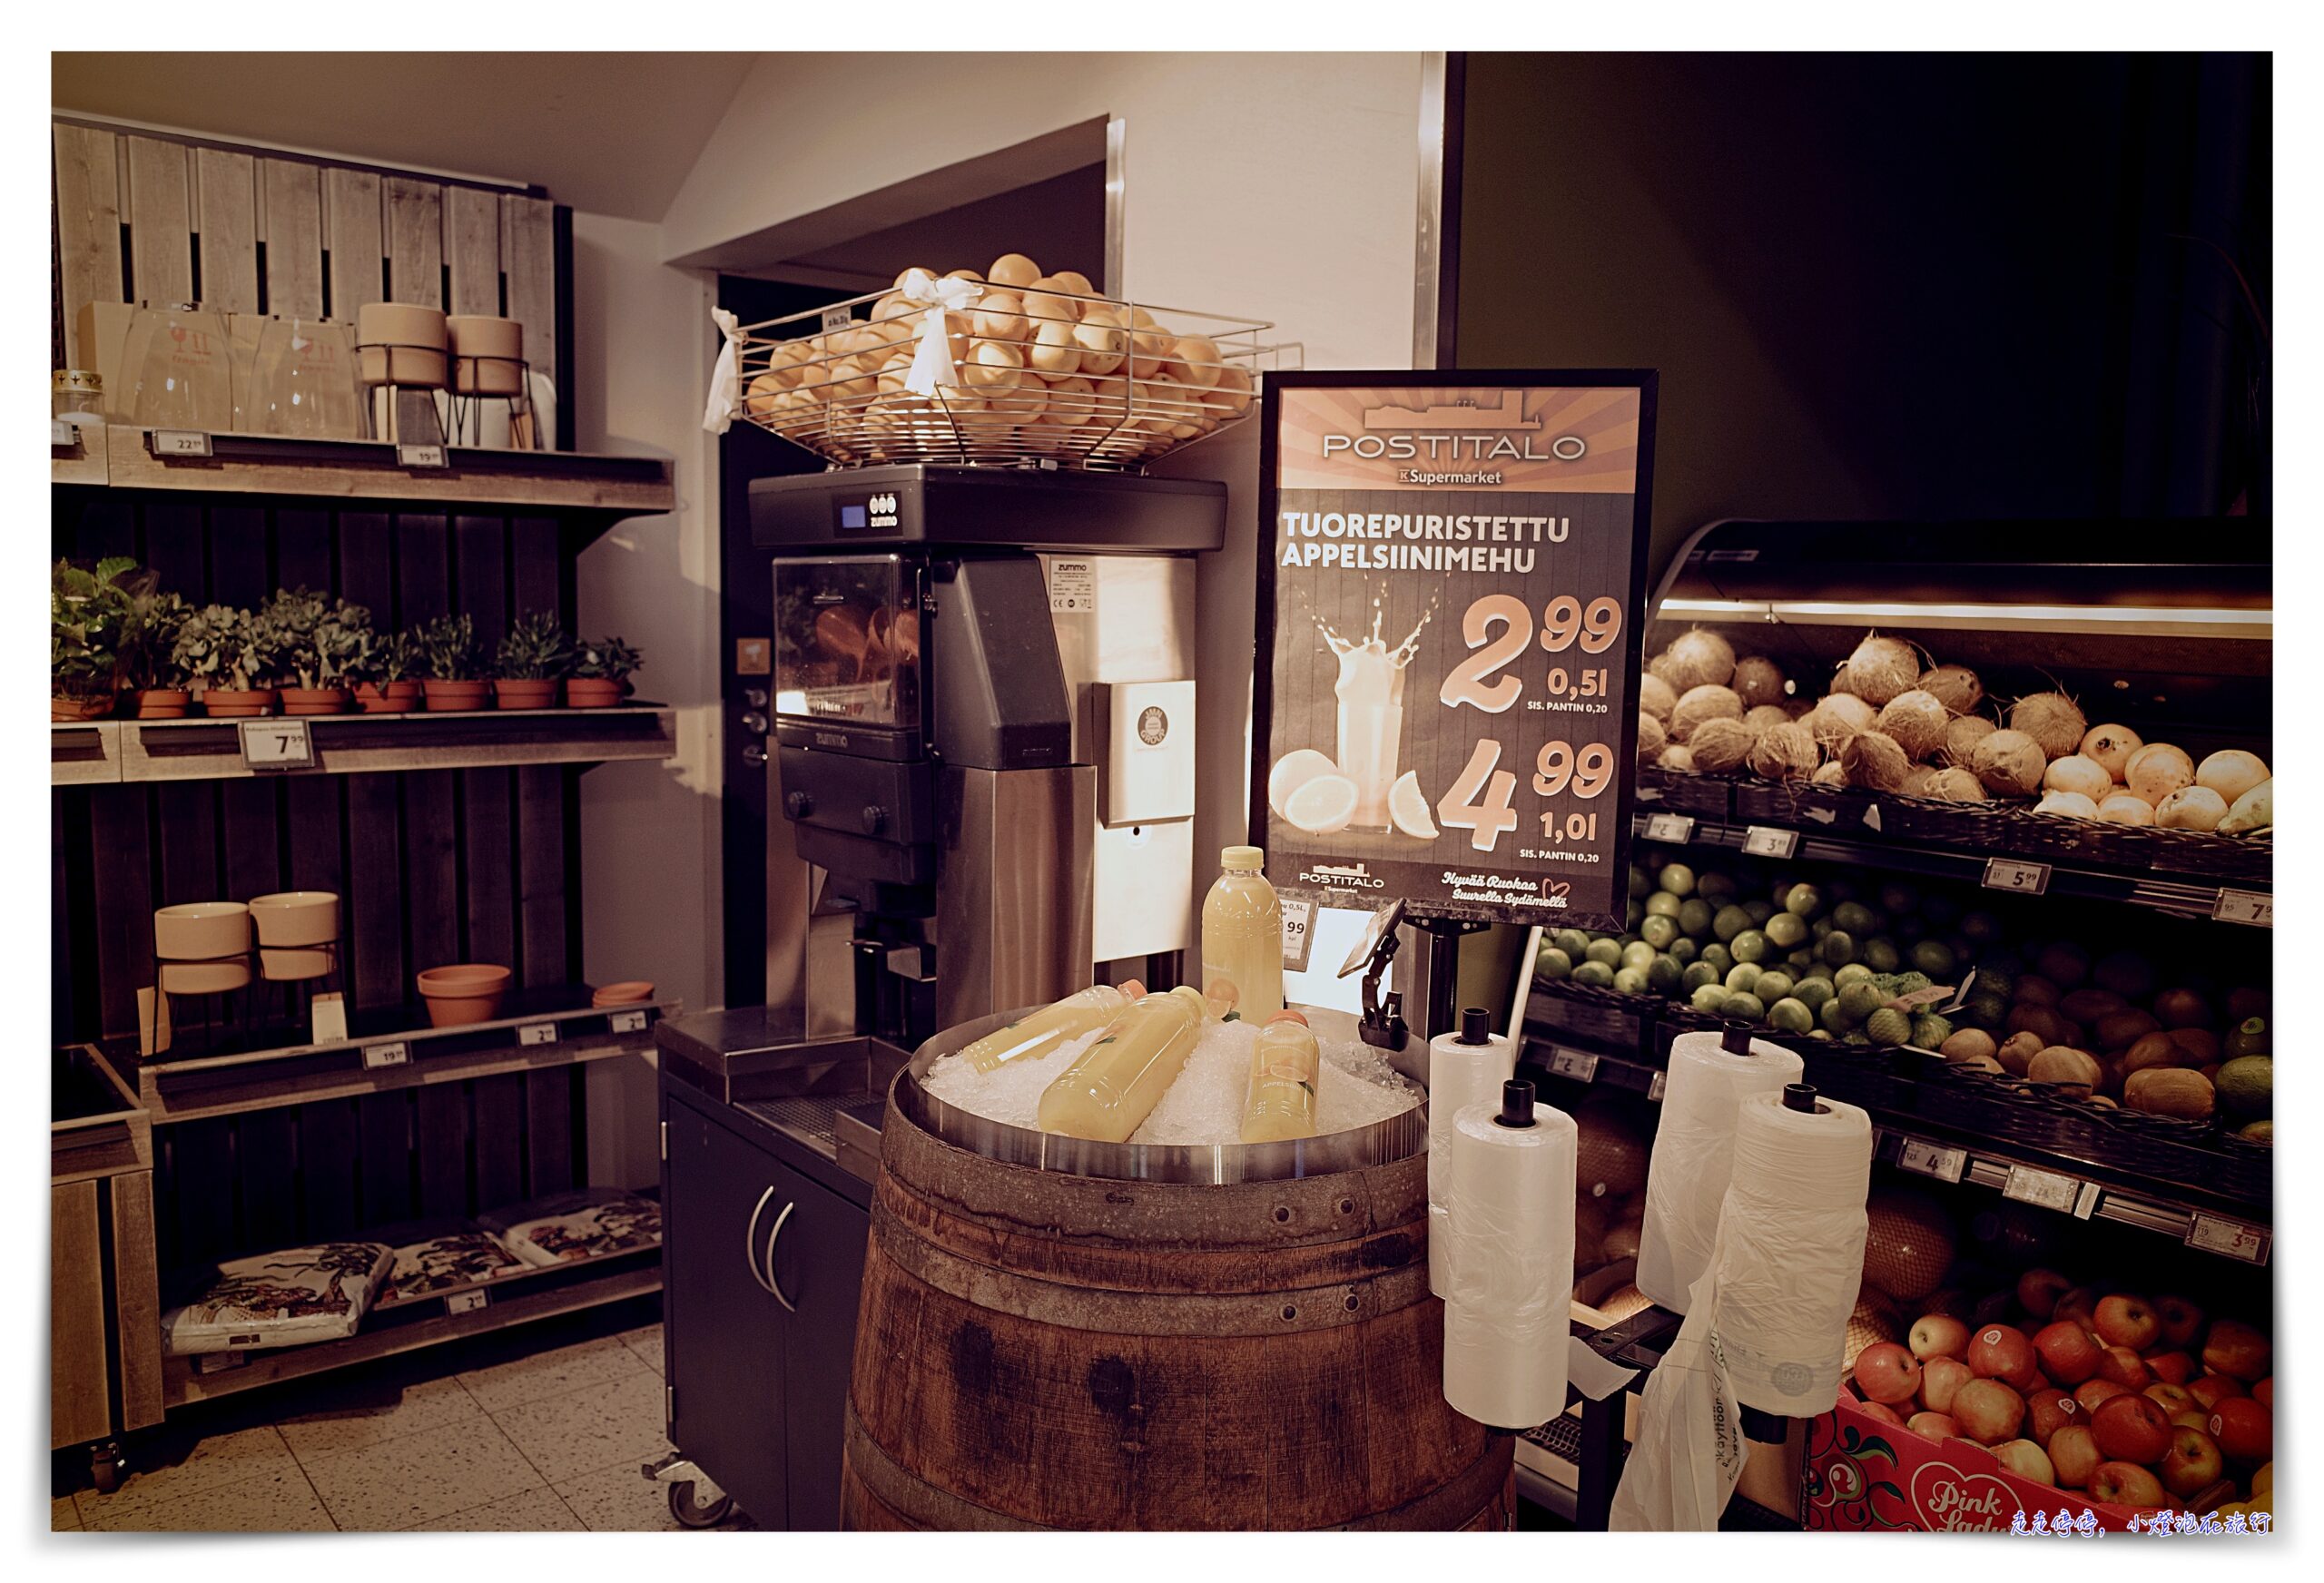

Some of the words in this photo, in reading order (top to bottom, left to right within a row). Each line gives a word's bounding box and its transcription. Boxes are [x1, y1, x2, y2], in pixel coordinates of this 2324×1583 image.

[1323, 435, 1586, 460] POSTITALO
[1410, 469, 1502, 486] Supermarket
[1282, 512, 1570, 543] TUOREPURISTETTU
[1281, 543, 1535, 574] APPELSIINIMEHU
[1439, 595, 1533, 713] 2
[1540, 595, 1622, 654] 99
[1527, 701, 1545, 711] SIS.
[1546, 702, 1584, 713] PANTIN
[1585, 703, 1608, 713] 0,20
[275, 736, 289, 754] 7
[1437, 738, 1518, 852] 4
[1532, 741, 1614, 800] 99
[1520, 849, 1537, 859] SIS.
[1539, 850, 1576, 861] PANTIN
[1577, 853, 1600, 863] 0,20
[1299, 872, 1384, 888] POSTITALO
[1441, 871, 1485, 888] Hyvää
[1486, 875, 1538, 891] Ruokaa
[2013, 871, 2024, 886] 5
[1452, 888, 1502, 903] Suurella
[1503, 893, 1568, 908] Sydämellä
[2251, 903, 2265, 919] 7
[1287, 921, 1305, 934] 99
[1926, 1155, 1938, 1171] 4
[2231, 1234, 2243, 1248] 3
[1928, 1480, 2003, 1516] Pink
